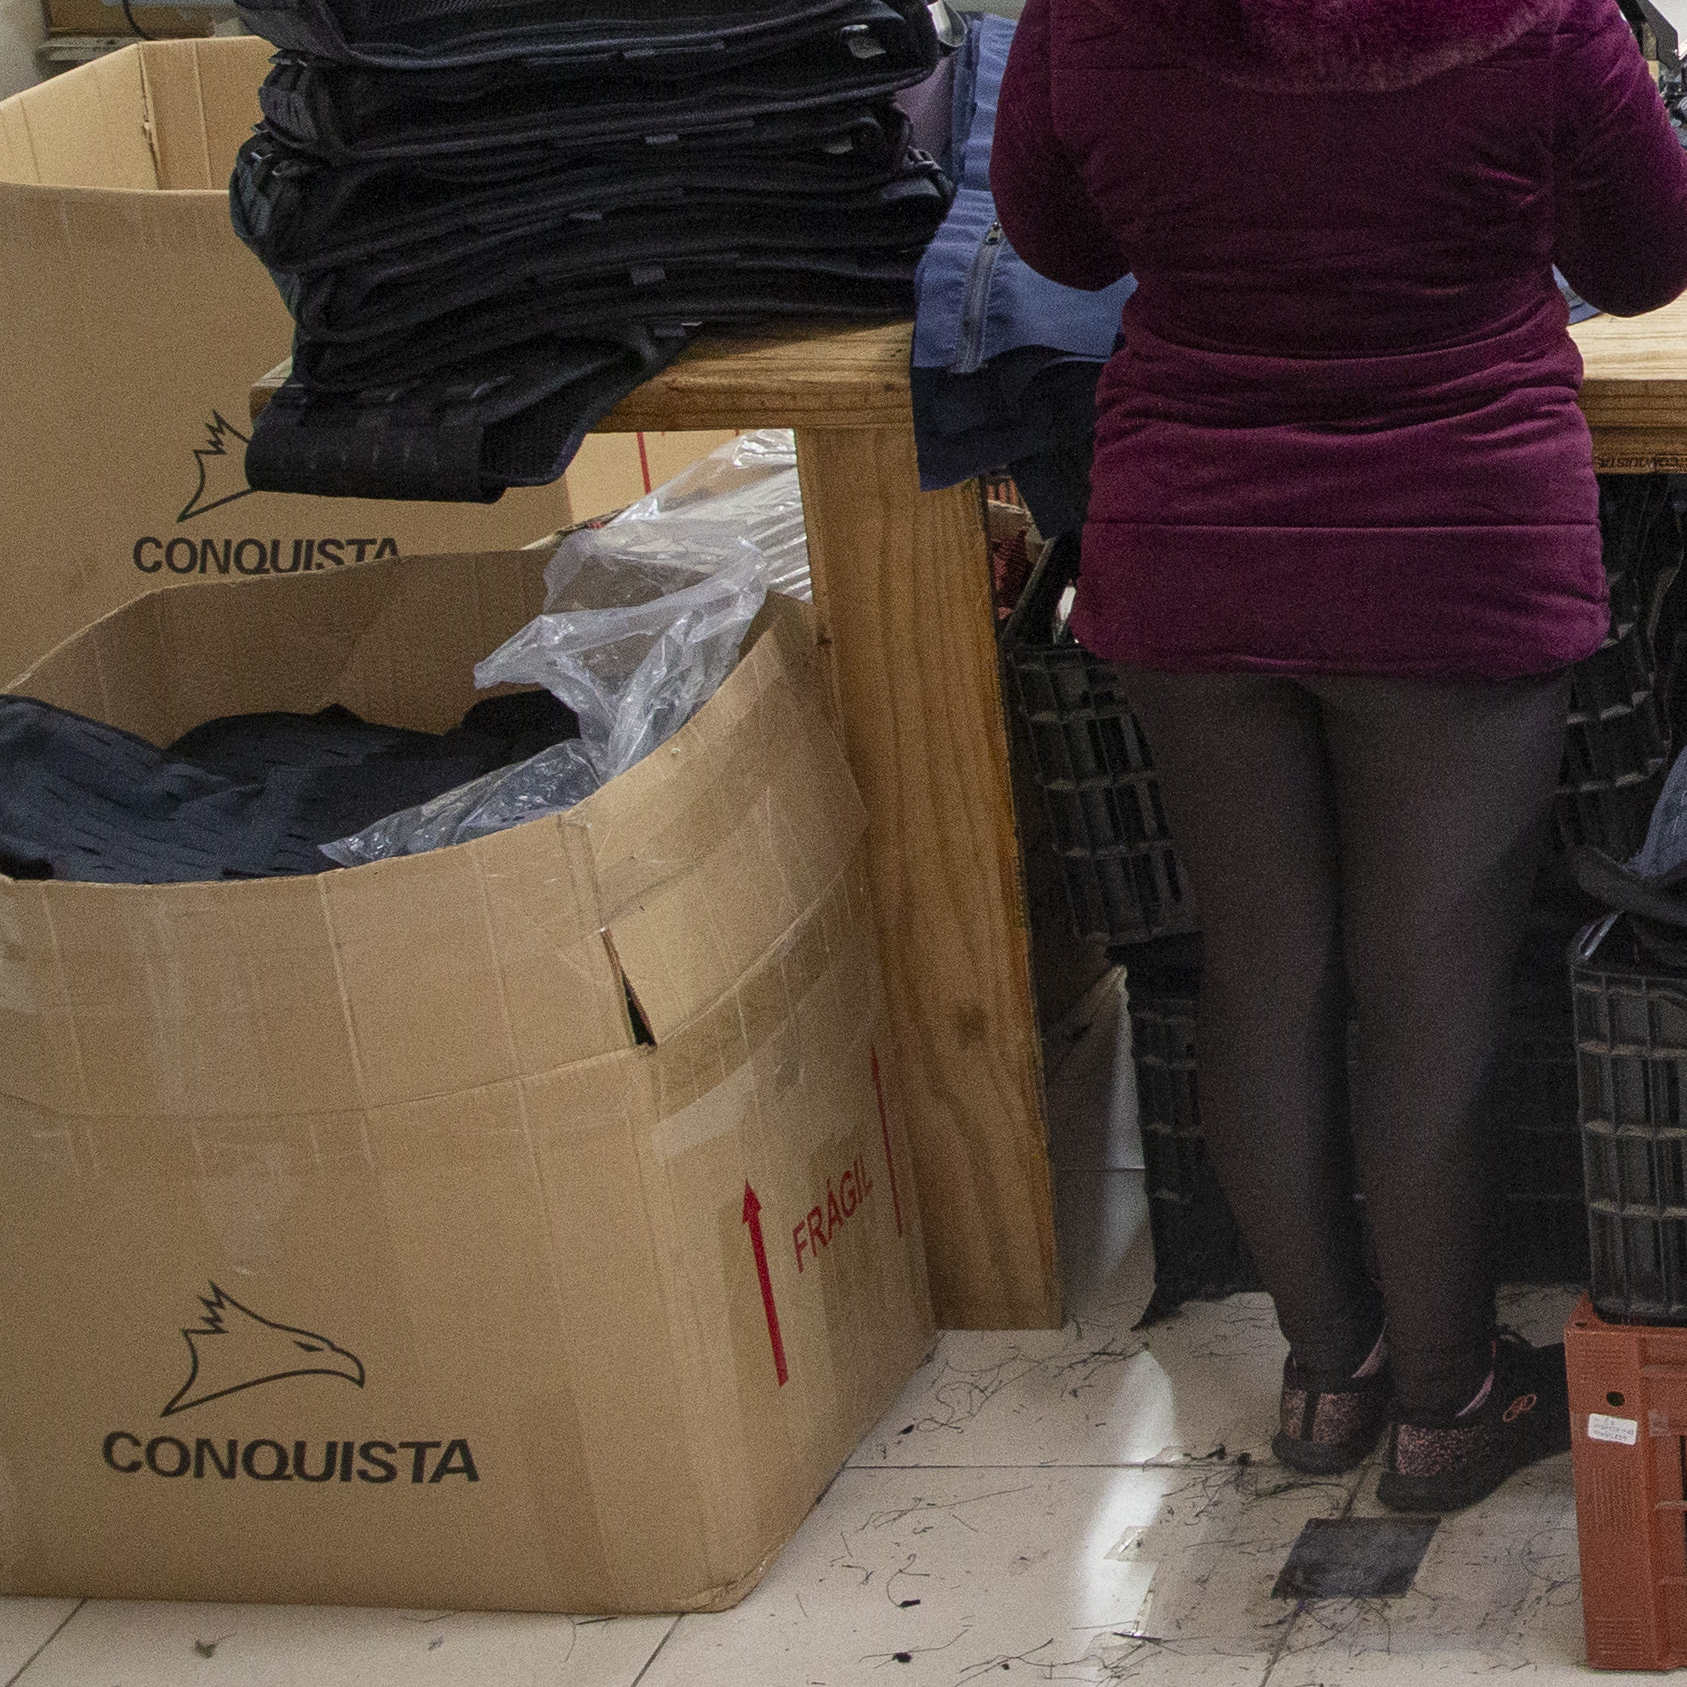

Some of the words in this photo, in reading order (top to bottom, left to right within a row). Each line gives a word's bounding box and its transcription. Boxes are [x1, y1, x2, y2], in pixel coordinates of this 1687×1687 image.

[132, 535, 400, 575] CONQUISTA
[792, 1152, 874, 1273] FRÁGIL
[102, 1429, 480, 1486] CONQUISTA
